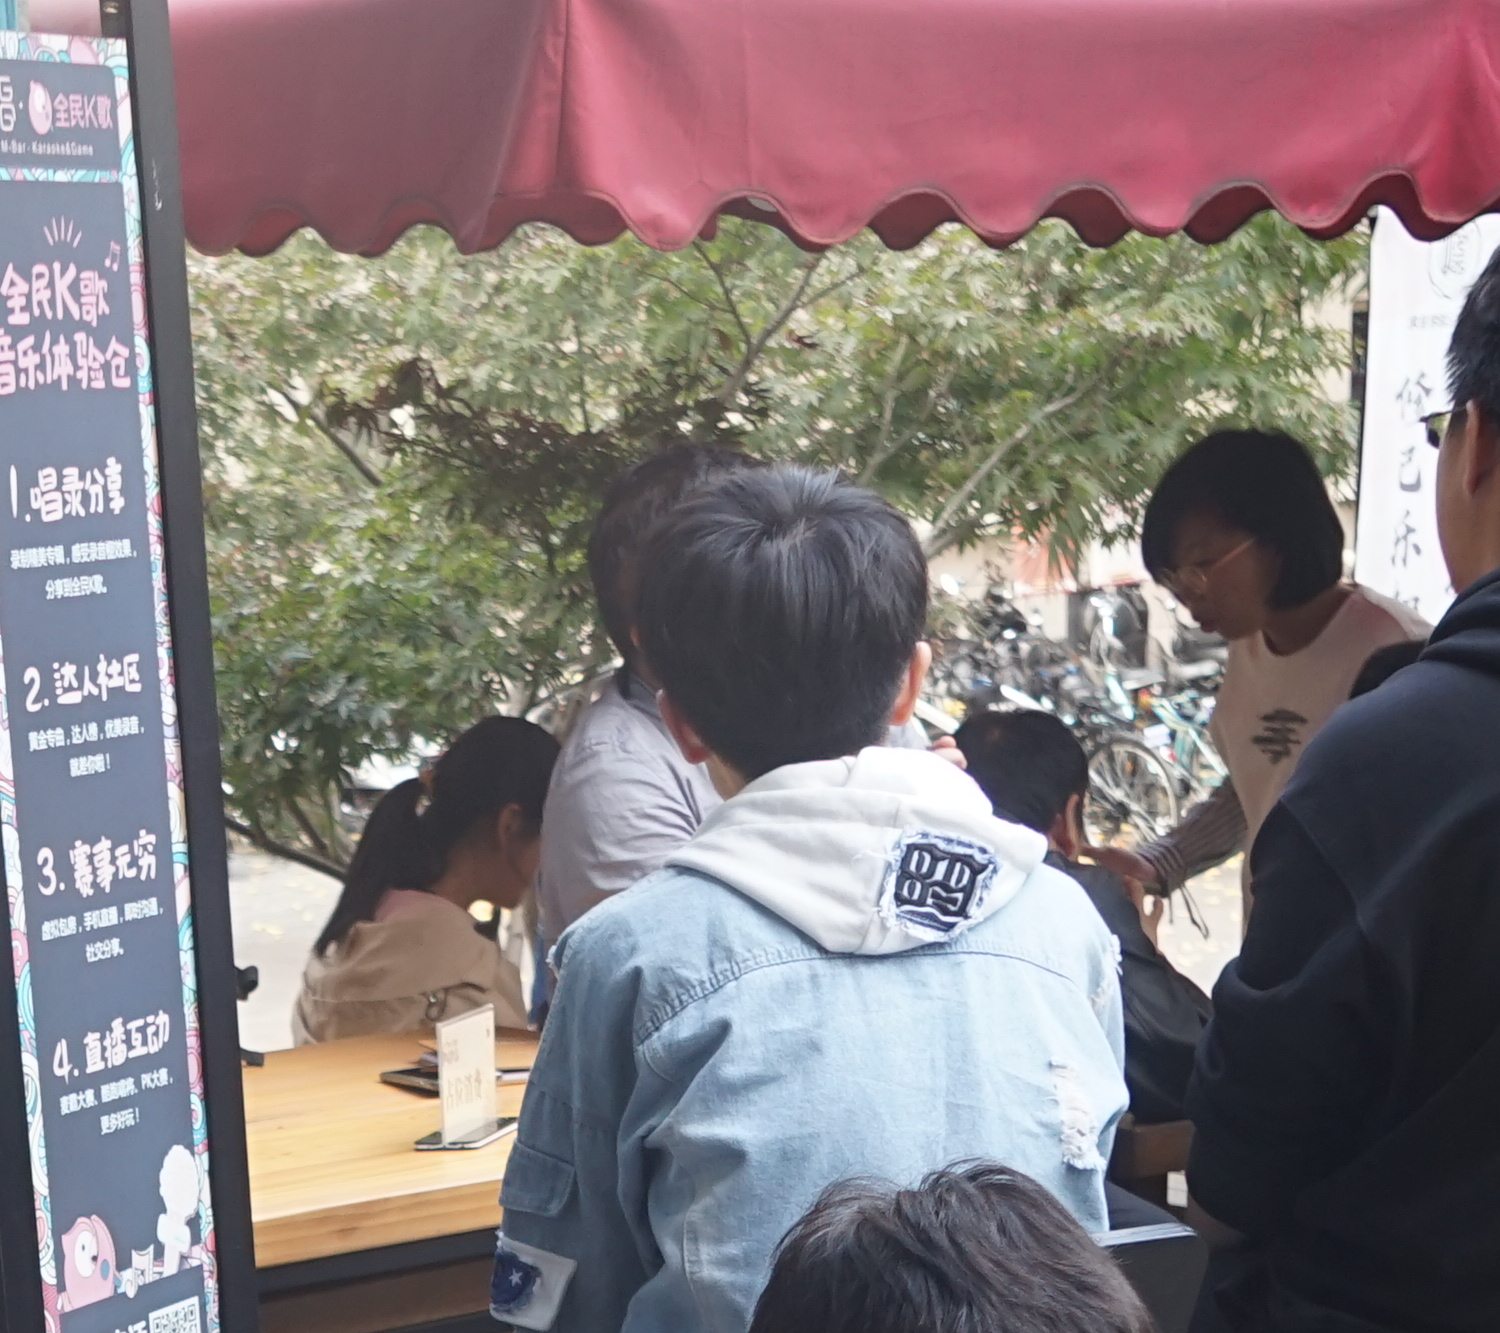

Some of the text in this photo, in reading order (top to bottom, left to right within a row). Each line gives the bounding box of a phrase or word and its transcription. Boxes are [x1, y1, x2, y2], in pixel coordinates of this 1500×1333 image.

[54, 92, 114, 131] 全民K歌
[0, 260, 110, 327] 全民K歌
[10, 456, 125, 523] 1.唱录分享
[23, 653, 143, 713] 2.达人社区
[53, 1009, 170, 1085] 4.直播互动
